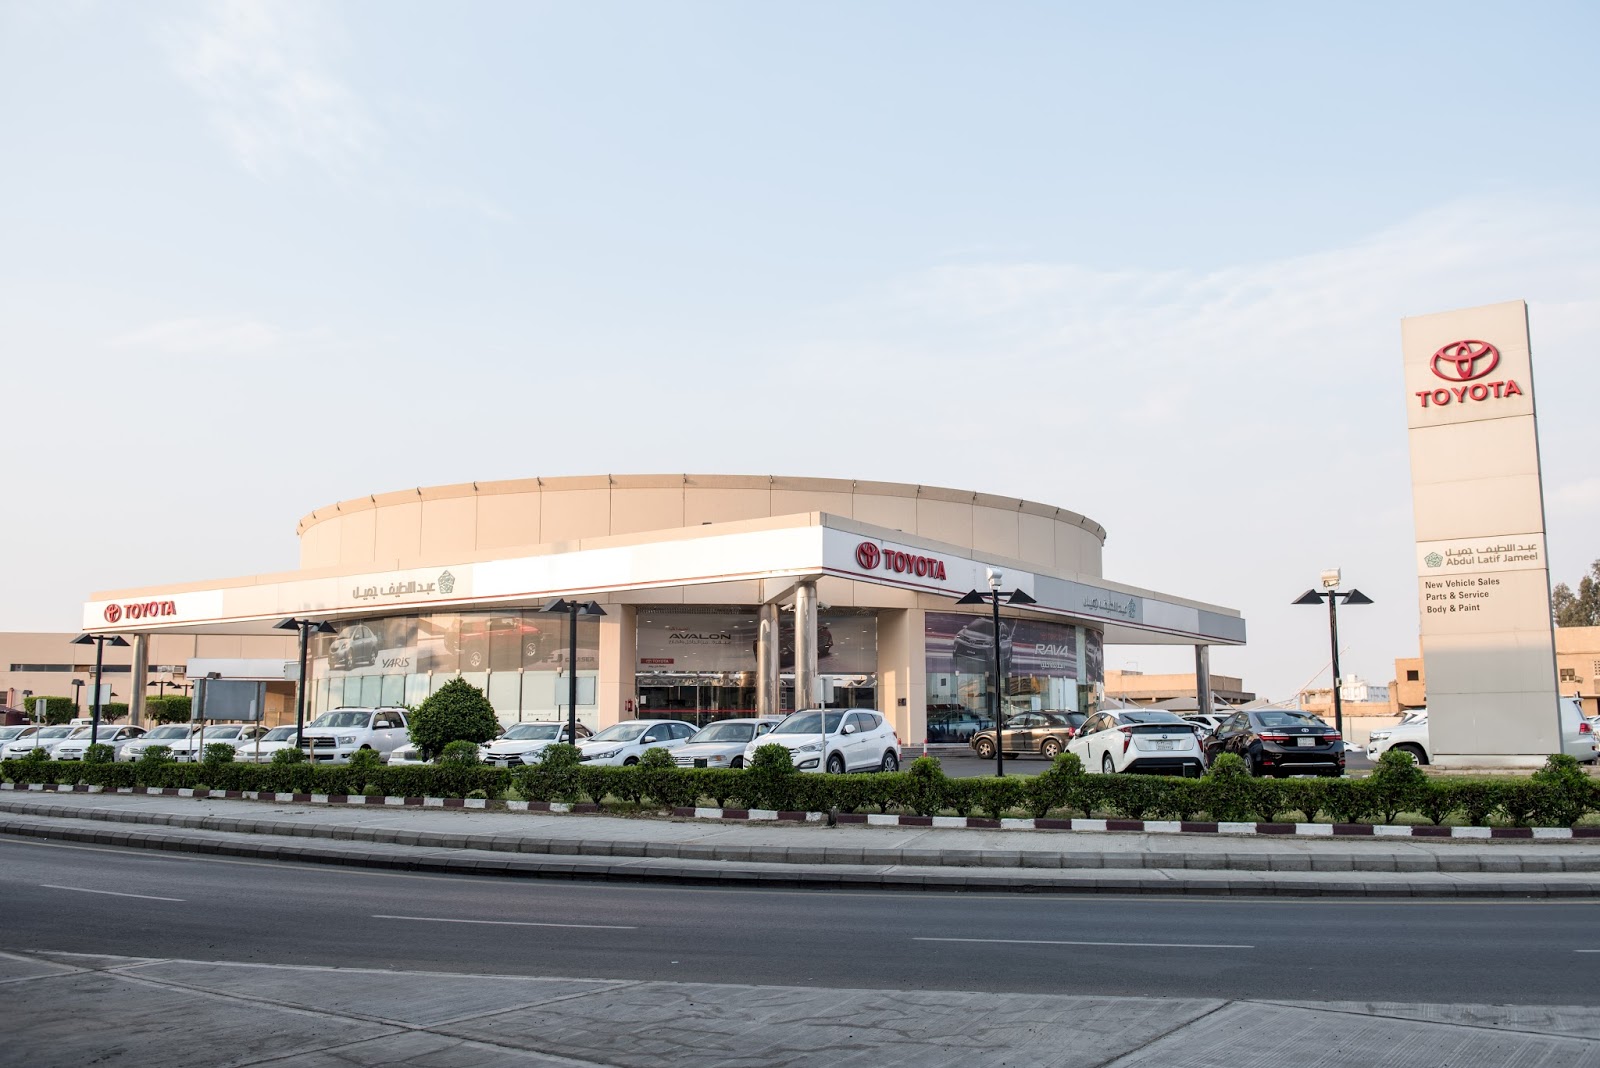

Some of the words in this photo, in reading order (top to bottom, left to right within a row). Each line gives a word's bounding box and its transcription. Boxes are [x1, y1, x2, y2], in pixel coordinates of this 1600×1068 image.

[1415, 380, 1522, 407] TOYOTA
[1445, 547, 1474, 557] جميل
[1476, 544, 1516, 554] اللطيف
[1517, 543, 1537, 553] عبد
[882, 549, 946, 580] TOYOTA
[1446, 556, 1475, 566] Abdul
[1477, 554, 1501, 564] Latif
[1503, 551, 1538, 562] Jameel
[380, 581, 416, 598] اللطيف
[416, 582, 436, 595] عبد
[1425, 581, 1443, 589] New
[1445, 579, 1476, 588] Vehicle
[1478, 577, 1500, 586] Sales
[352, 586, 379, 600] جميل
[1426, 592, 1447, 601] Parts
[1449, 591, 1457, 600] &
[1458, 590, 1490, 599] Service
[123, 600, 177, 619] TOYOTA
[1427, 605, 1447, 614] Body
[1449, 603, 1457, 612] &
[1458, 603, 1480, 612] Paint
[1034, 643, 1069, 657] RAV4
